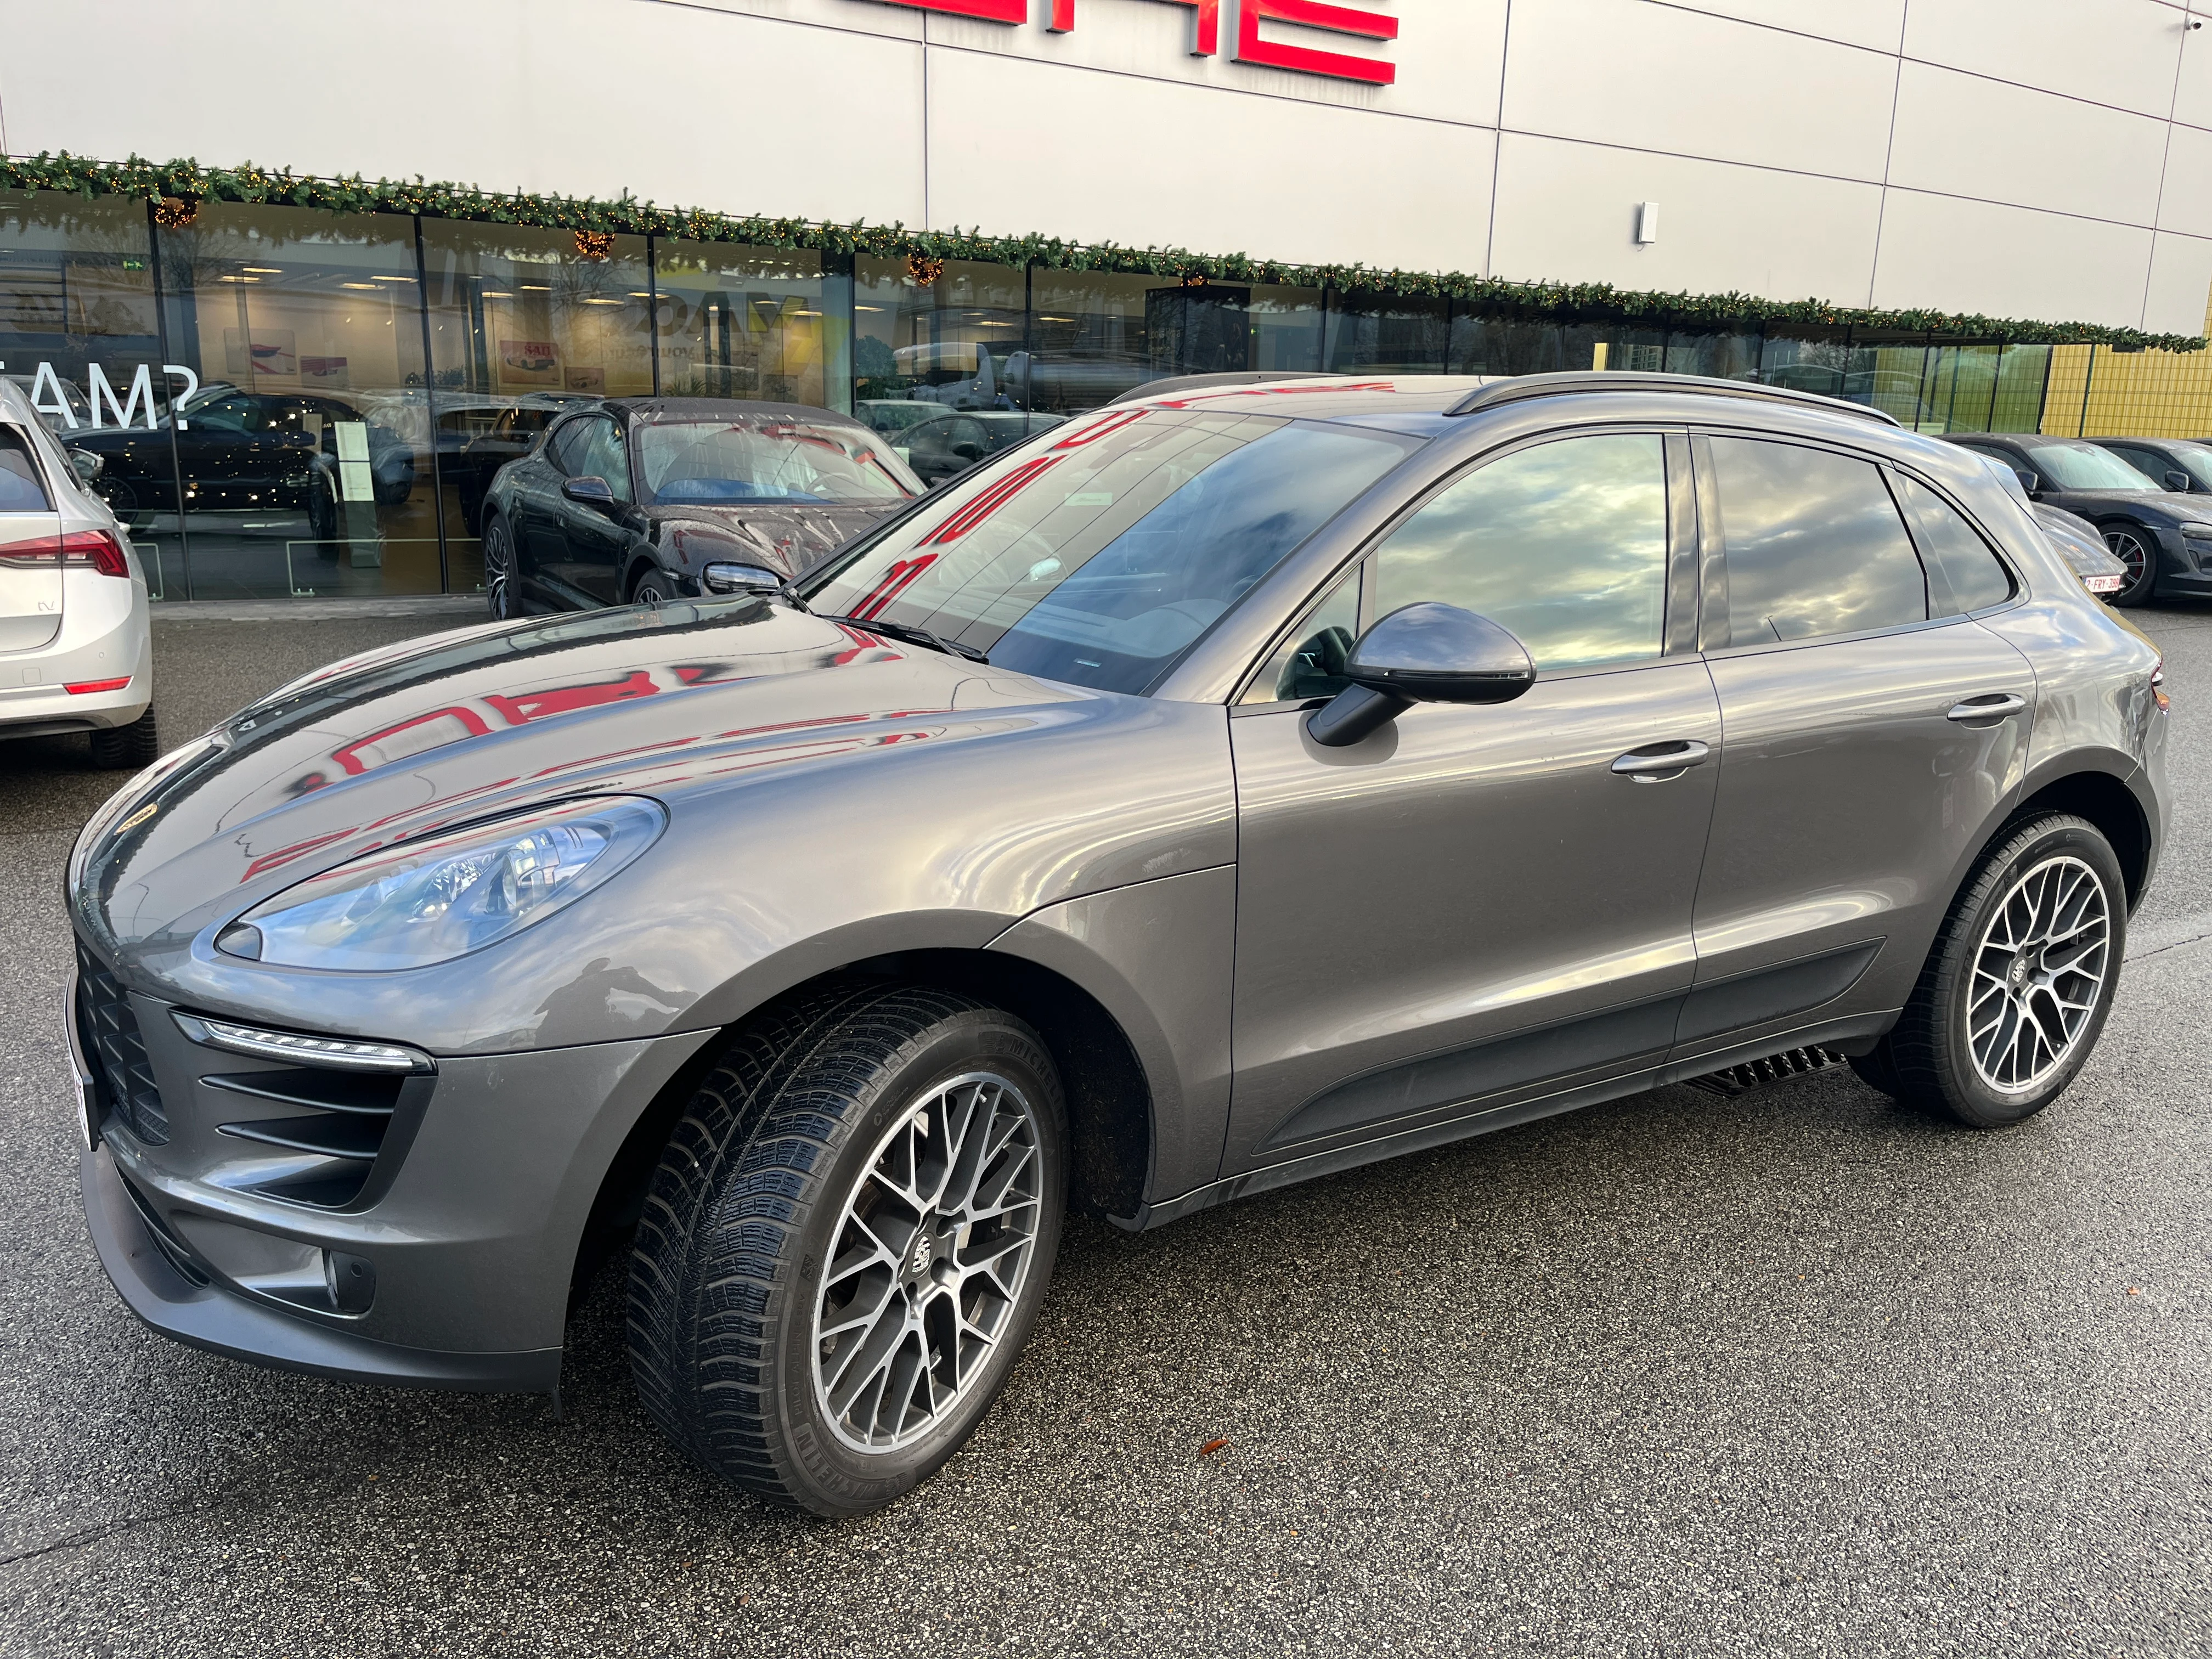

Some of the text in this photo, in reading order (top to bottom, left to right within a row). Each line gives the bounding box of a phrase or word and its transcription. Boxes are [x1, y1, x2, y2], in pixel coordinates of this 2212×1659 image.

[0, 360, 199, 431] AM?
[1009, 1038, 1066, 1123] MICHELIN
[792, 1381, 803, 1416] PILOT
